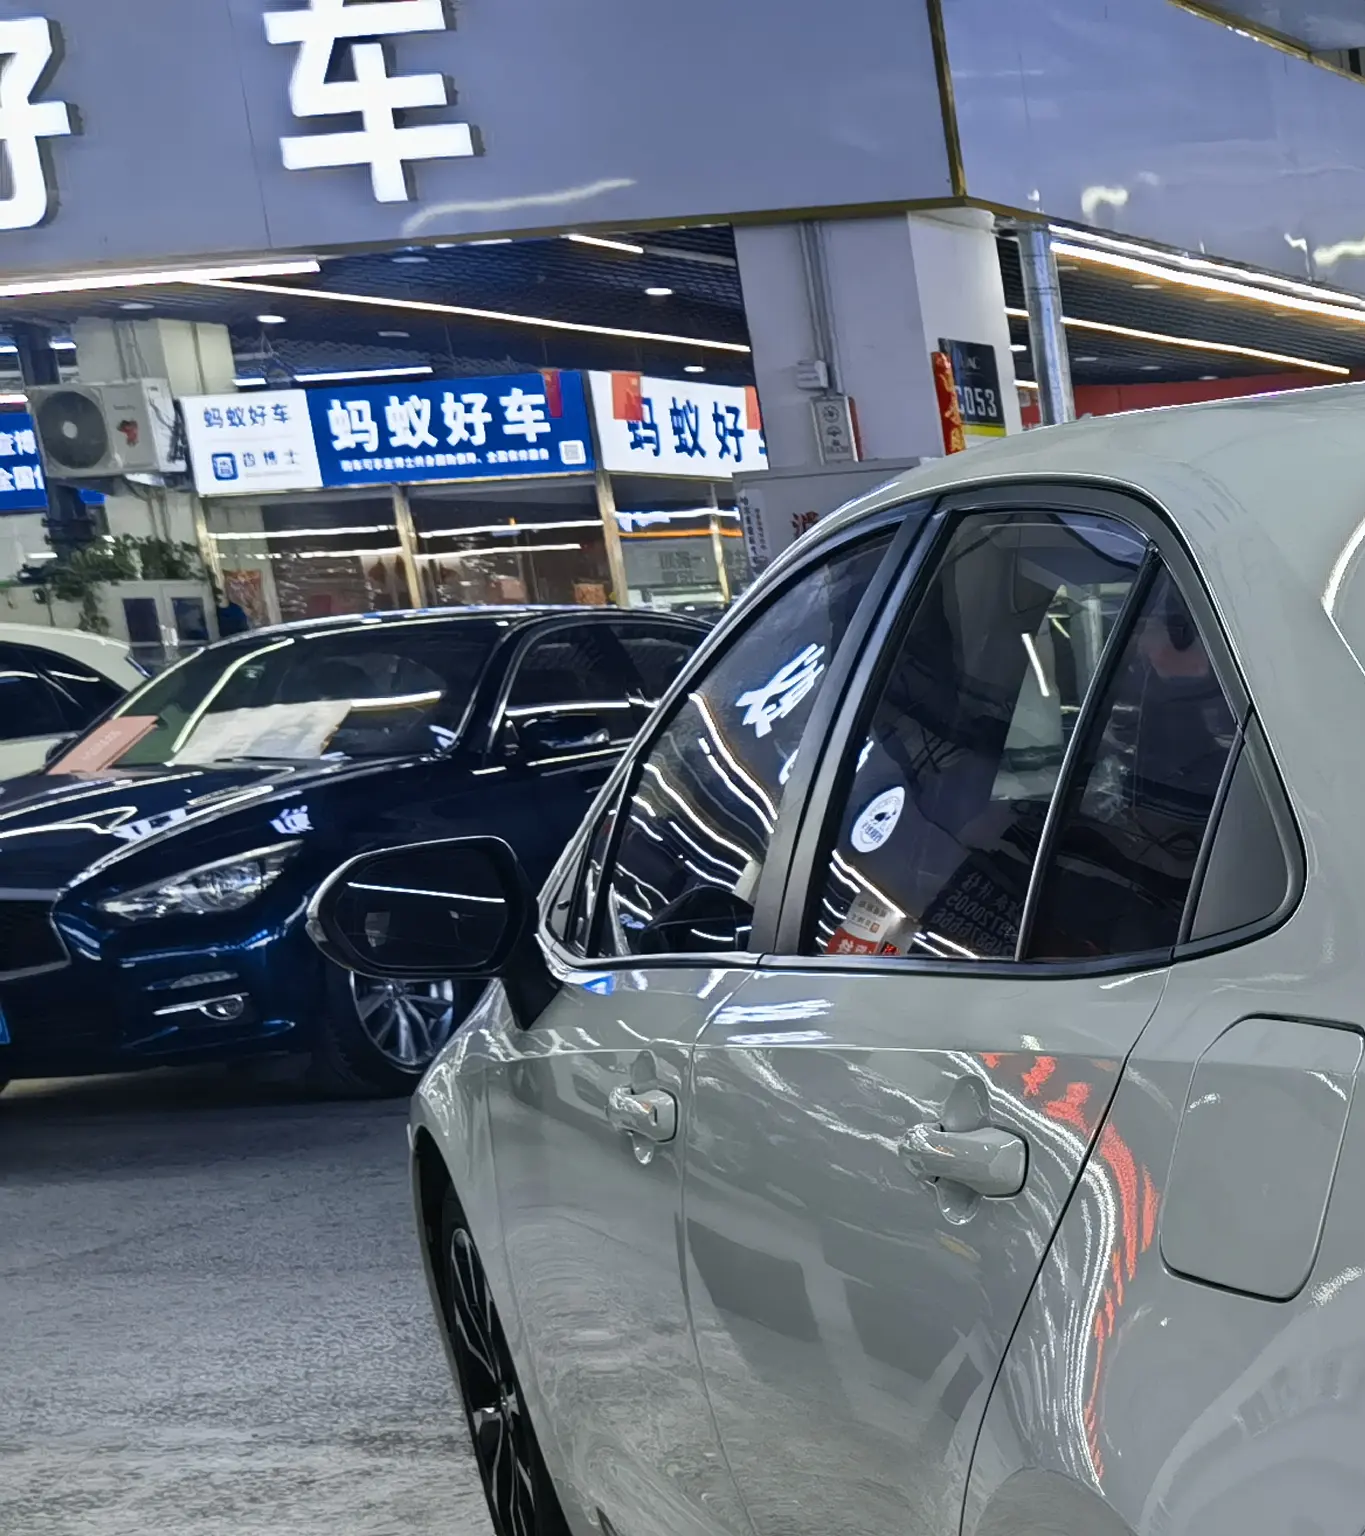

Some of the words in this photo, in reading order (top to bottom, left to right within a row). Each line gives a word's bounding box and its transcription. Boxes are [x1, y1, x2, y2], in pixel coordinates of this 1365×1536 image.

[203, 403, 292, 429] 蚂蚁好车
[327, 388, 552, 453] 蚂蚁好车
[625, 396, 767, 463] 蚂蚁好
